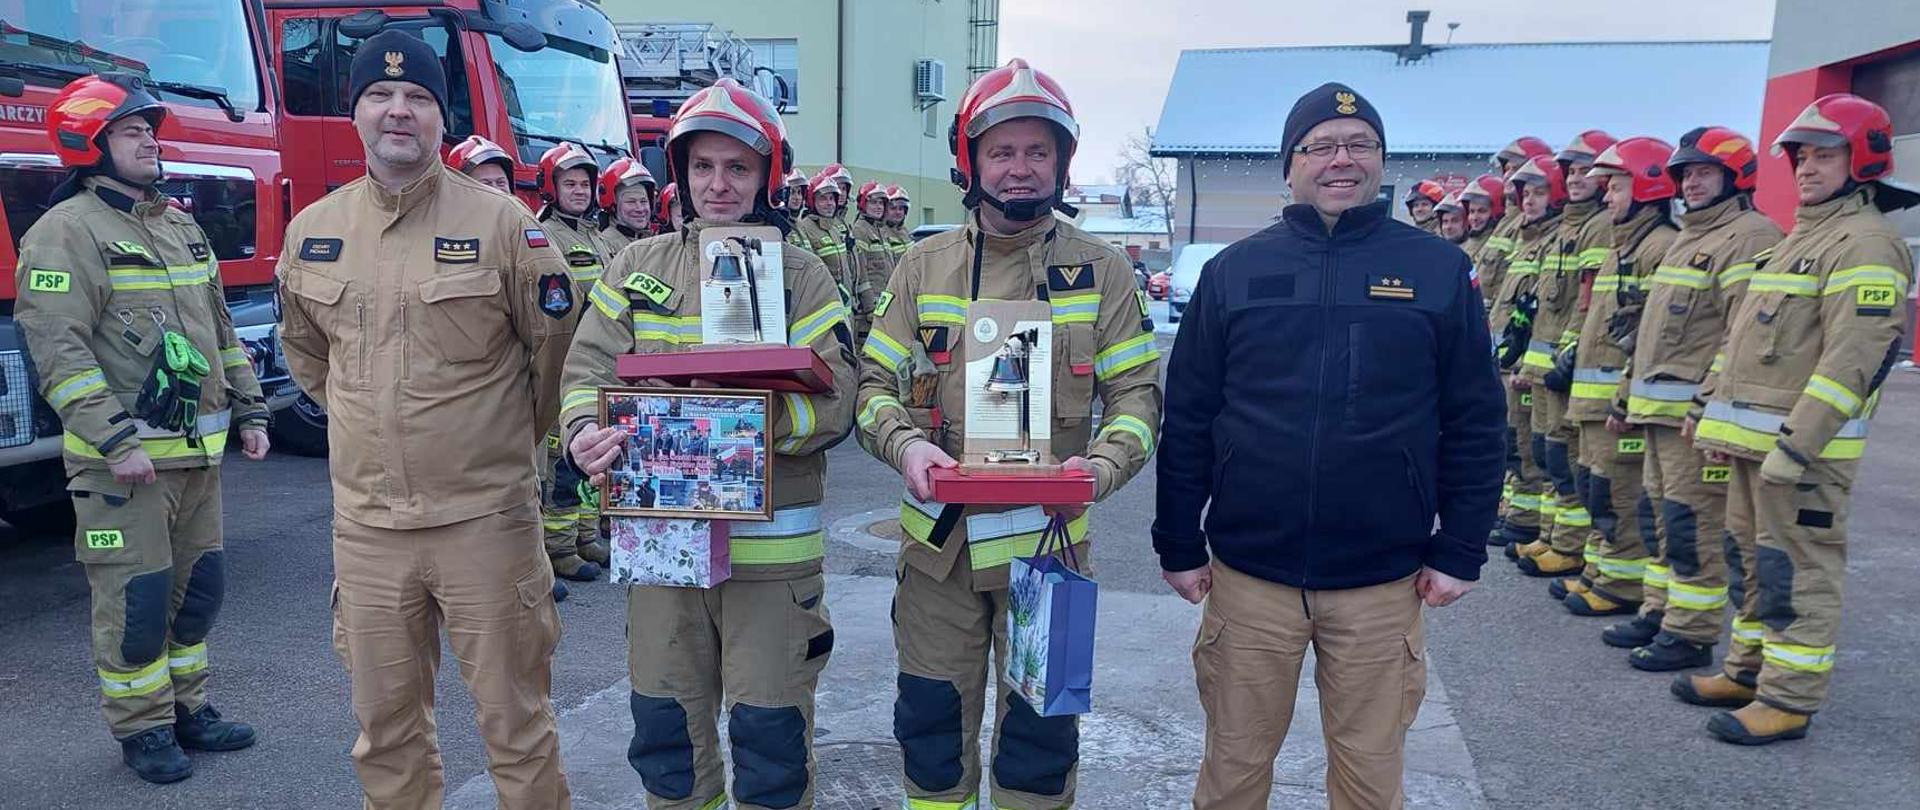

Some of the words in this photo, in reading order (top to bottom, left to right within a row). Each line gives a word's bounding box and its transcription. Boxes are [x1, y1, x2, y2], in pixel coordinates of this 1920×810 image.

[35, 273, 64, 289] PSP
[630, 274, 665, 295] PSP
[1863, 290, 1890, 301] PSP
[1706, 469, 1729, 480] PSP
[90, 533, 118, 547] PSP
